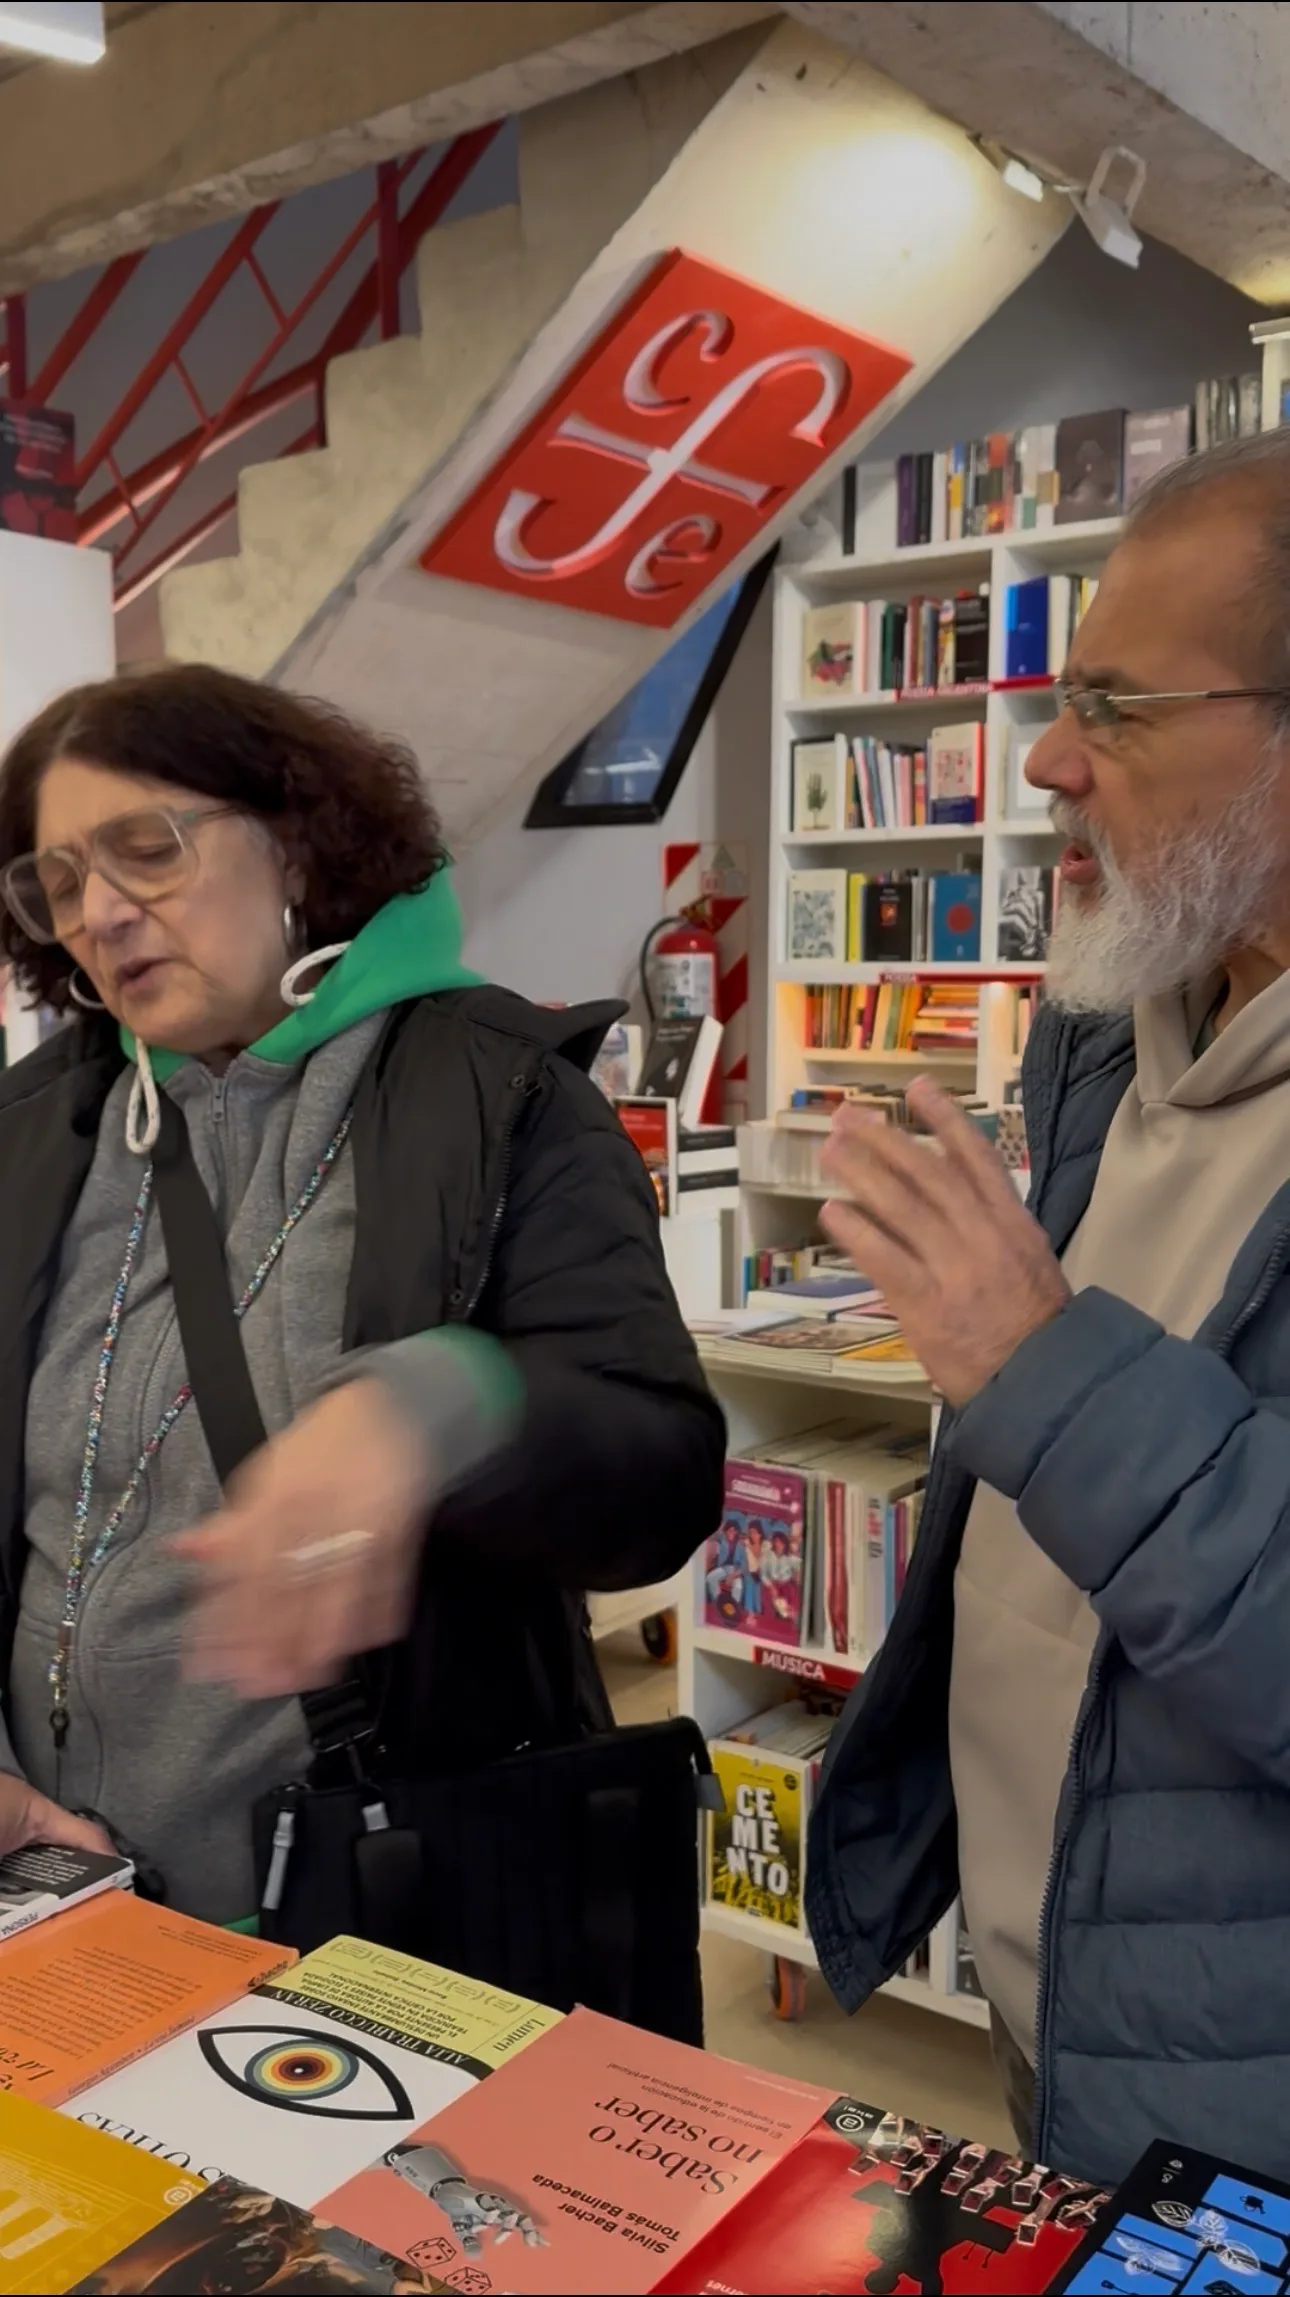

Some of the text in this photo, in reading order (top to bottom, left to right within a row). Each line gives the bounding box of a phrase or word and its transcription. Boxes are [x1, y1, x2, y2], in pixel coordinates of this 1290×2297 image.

[736, 1784, 775, 1819] CE
[732, 1815, 781, 1853] ME
[726, 1846, 790, 1896] NTO
[329, 2009, 422, 2050] TRABUCCO
[493, 2018, 546, 2052] Lumen
[425, 2045, 468, 2064] ALIA
[594, 2097, 762, 2163] no saber
[589, 2126, 738, 2194] Saber o
[532, 2174, 680, 2241] Tomás Balmaceda
[558, 2203, 669, 2253] Silvia Bacher
